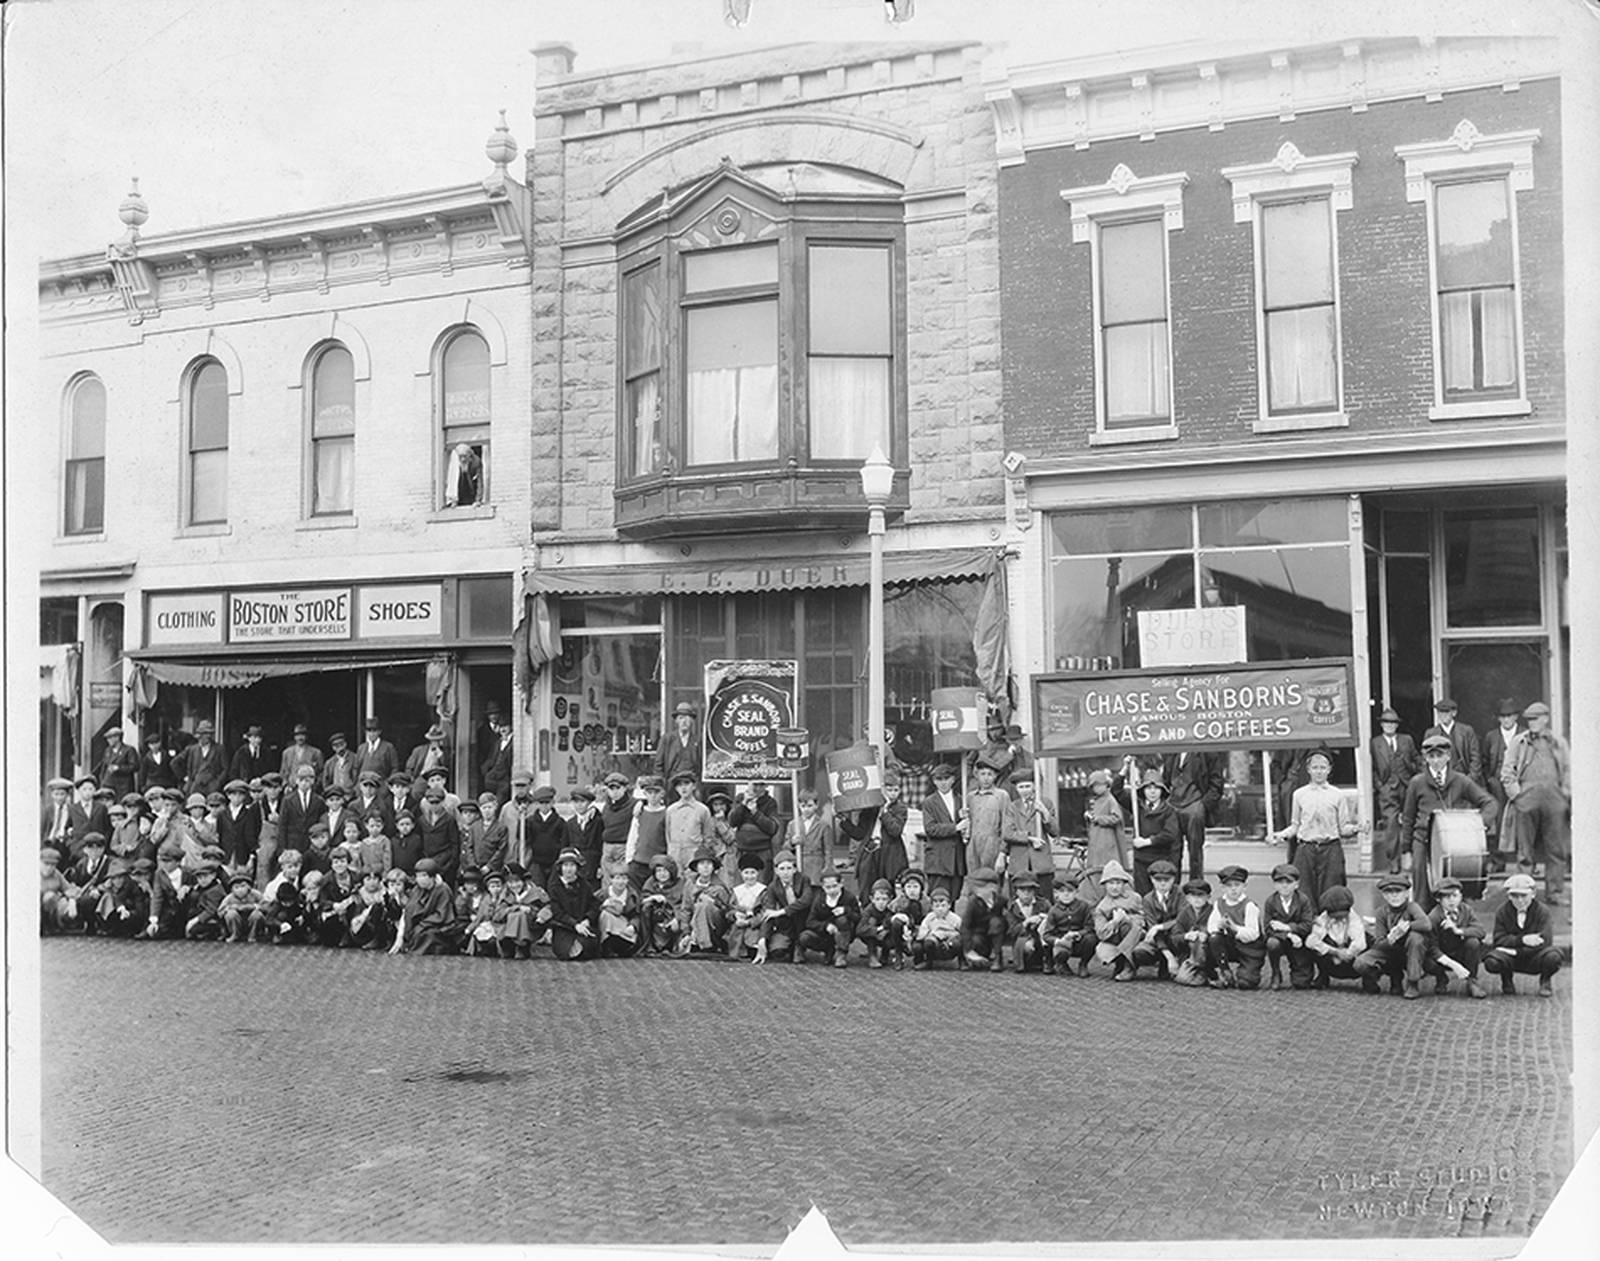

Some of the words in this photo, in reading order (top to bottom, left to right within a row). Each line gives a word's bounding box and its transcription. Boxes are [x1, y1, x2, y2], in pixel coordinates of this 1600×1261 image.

[707, 570, 732, 587] E.
[756, 566, 847, 587] DUER
[233, 598, 288, 625] BOSTON
[295, 594, 347, 623] STORE
[368, 601, 431, 621] SHOES
[157, 610, 216, 629] CLOTHING
[235, 627, 249, 637] THE
[251, 626, 274, 637] STORE
[278, 626, 297, 635] THAT
[299, 623, 347, 635] UNDERSELLS
[1145, 629, 1238, 652] STORE
[1086, 690, 1152, 716] CHASE
[1156, 695, 1170, 713] &
[1175, 677, 1302, 712] SANBORN'S
[737, 710, 766, 722] SEAL
[1131, 712, 1187, 723] FAMOUS
[1196, 710, 1253, 720] BOSTON
[733, 724, 769, 737] BRAND
[1094, 724, 1151, 743] TEAS
[1158, 727, 1186, 741] AND
[1193, 717, 1292, 740] COFFEES
[735, 738, 768, 752] COFFEE
